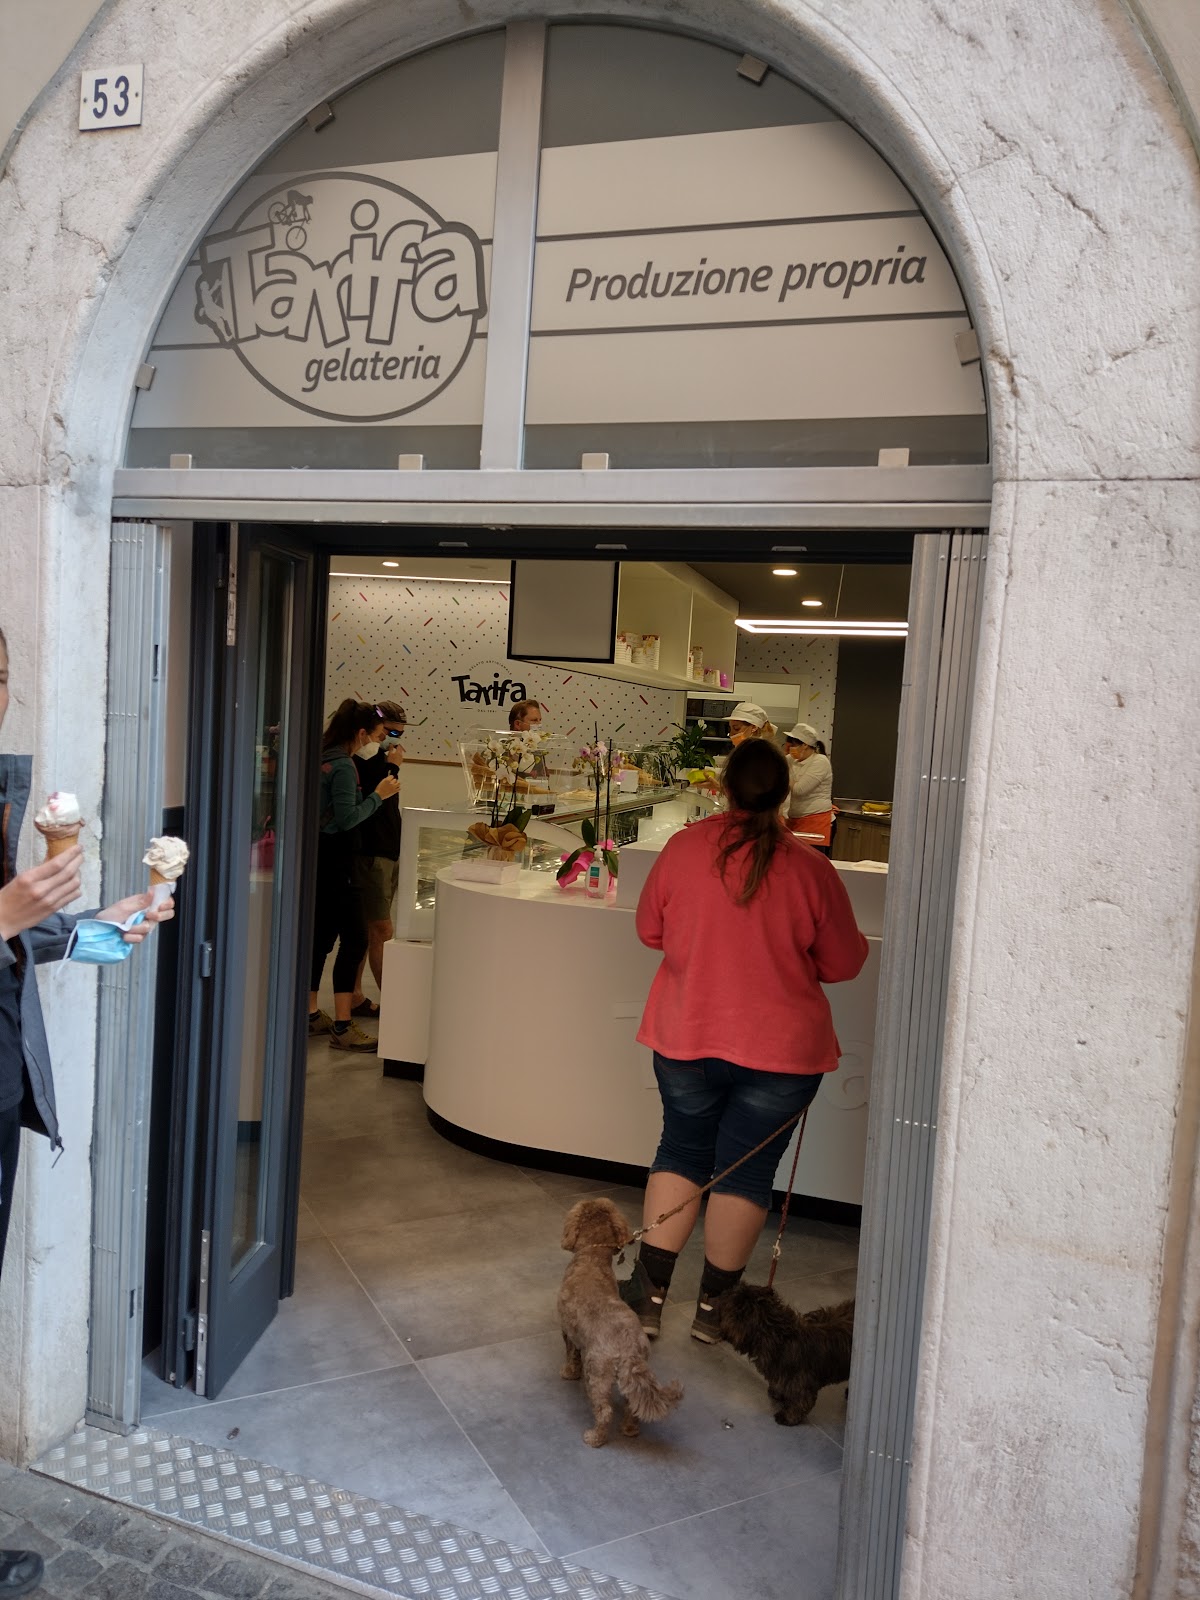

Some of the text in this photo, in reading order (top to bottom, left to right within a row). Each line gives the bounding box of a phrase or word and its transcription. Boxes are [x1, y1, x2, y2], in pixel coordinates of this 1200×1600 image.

[91, 75, 131, 119] 53
[203, 198, 487, 348] Tarifa
[565, 245, 927, 303] Produzione propria
[301, 345, 442, 393] gelateria
[451, 672, 526, 706] Tarifa
